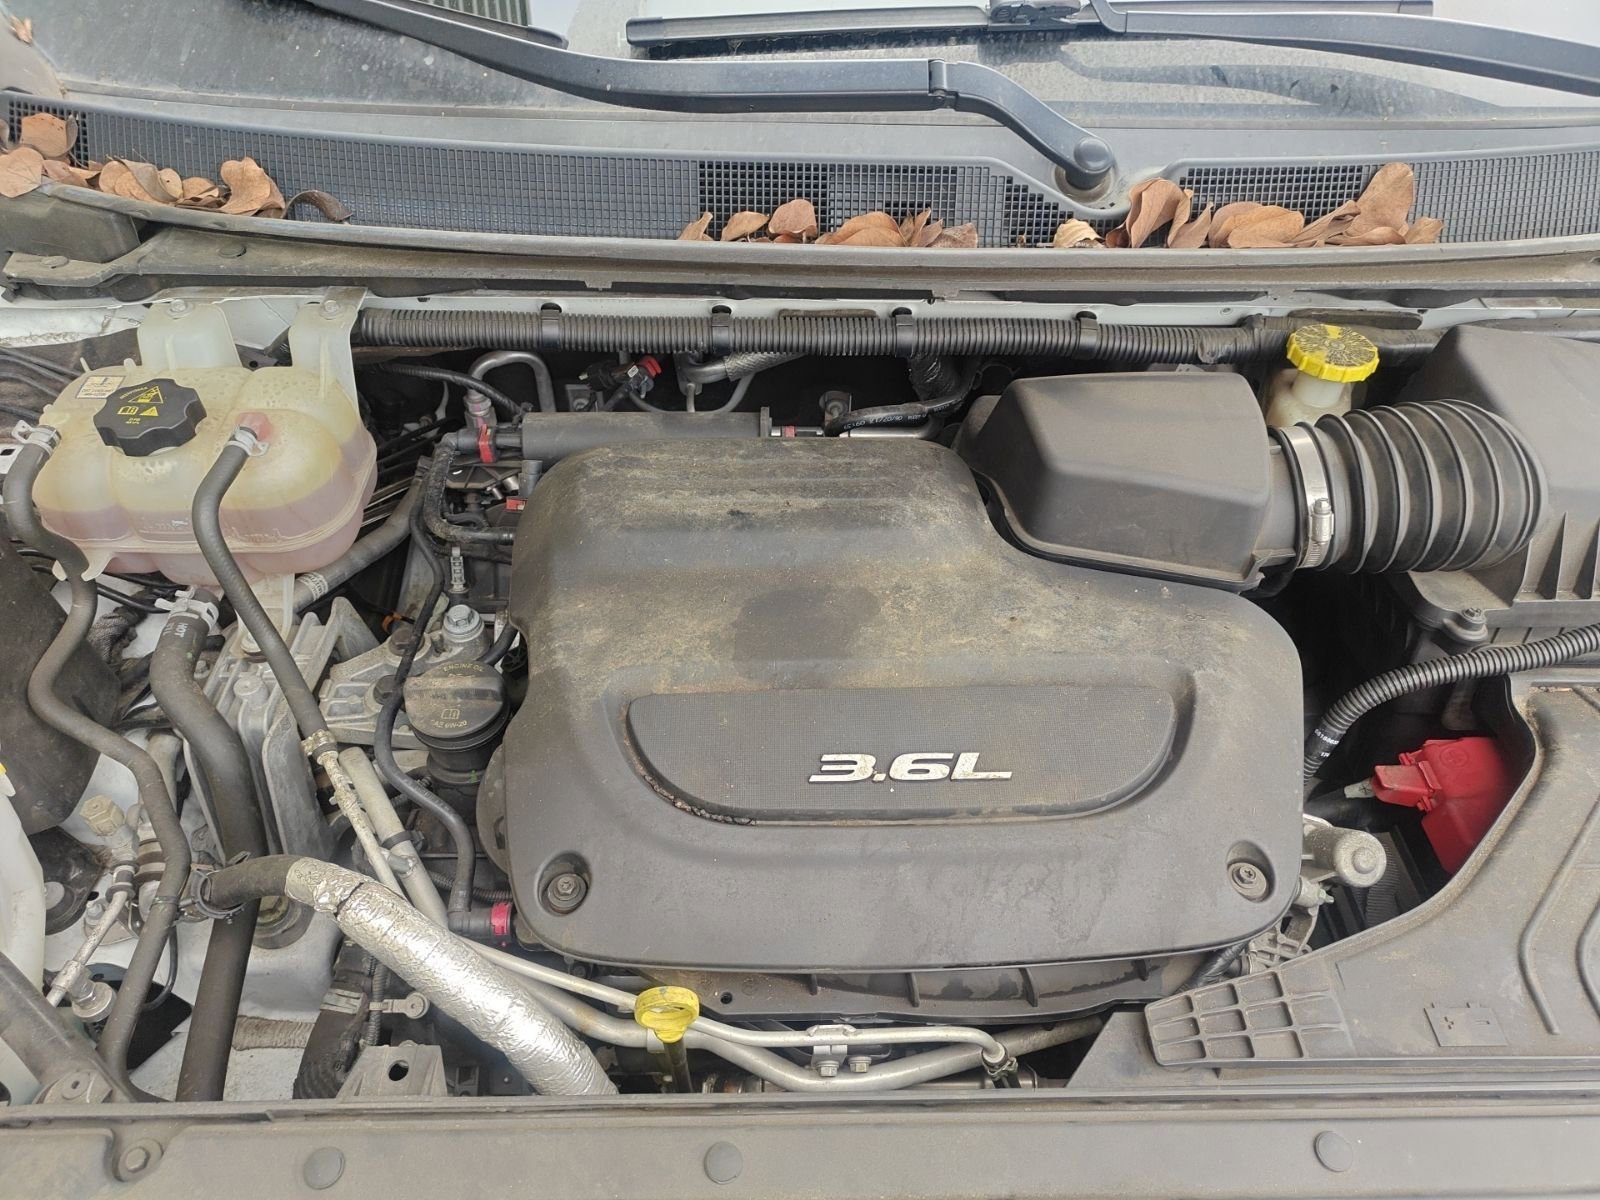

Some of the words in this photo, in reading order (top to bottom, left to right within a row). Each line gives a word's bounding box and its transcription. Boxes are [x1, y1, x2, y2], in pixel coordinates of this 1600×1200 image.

[175, 622, 189, 638] HOT
[443, 663, 472, 672] ENGINE
[808, 752, 1013, 782] 3.6L
